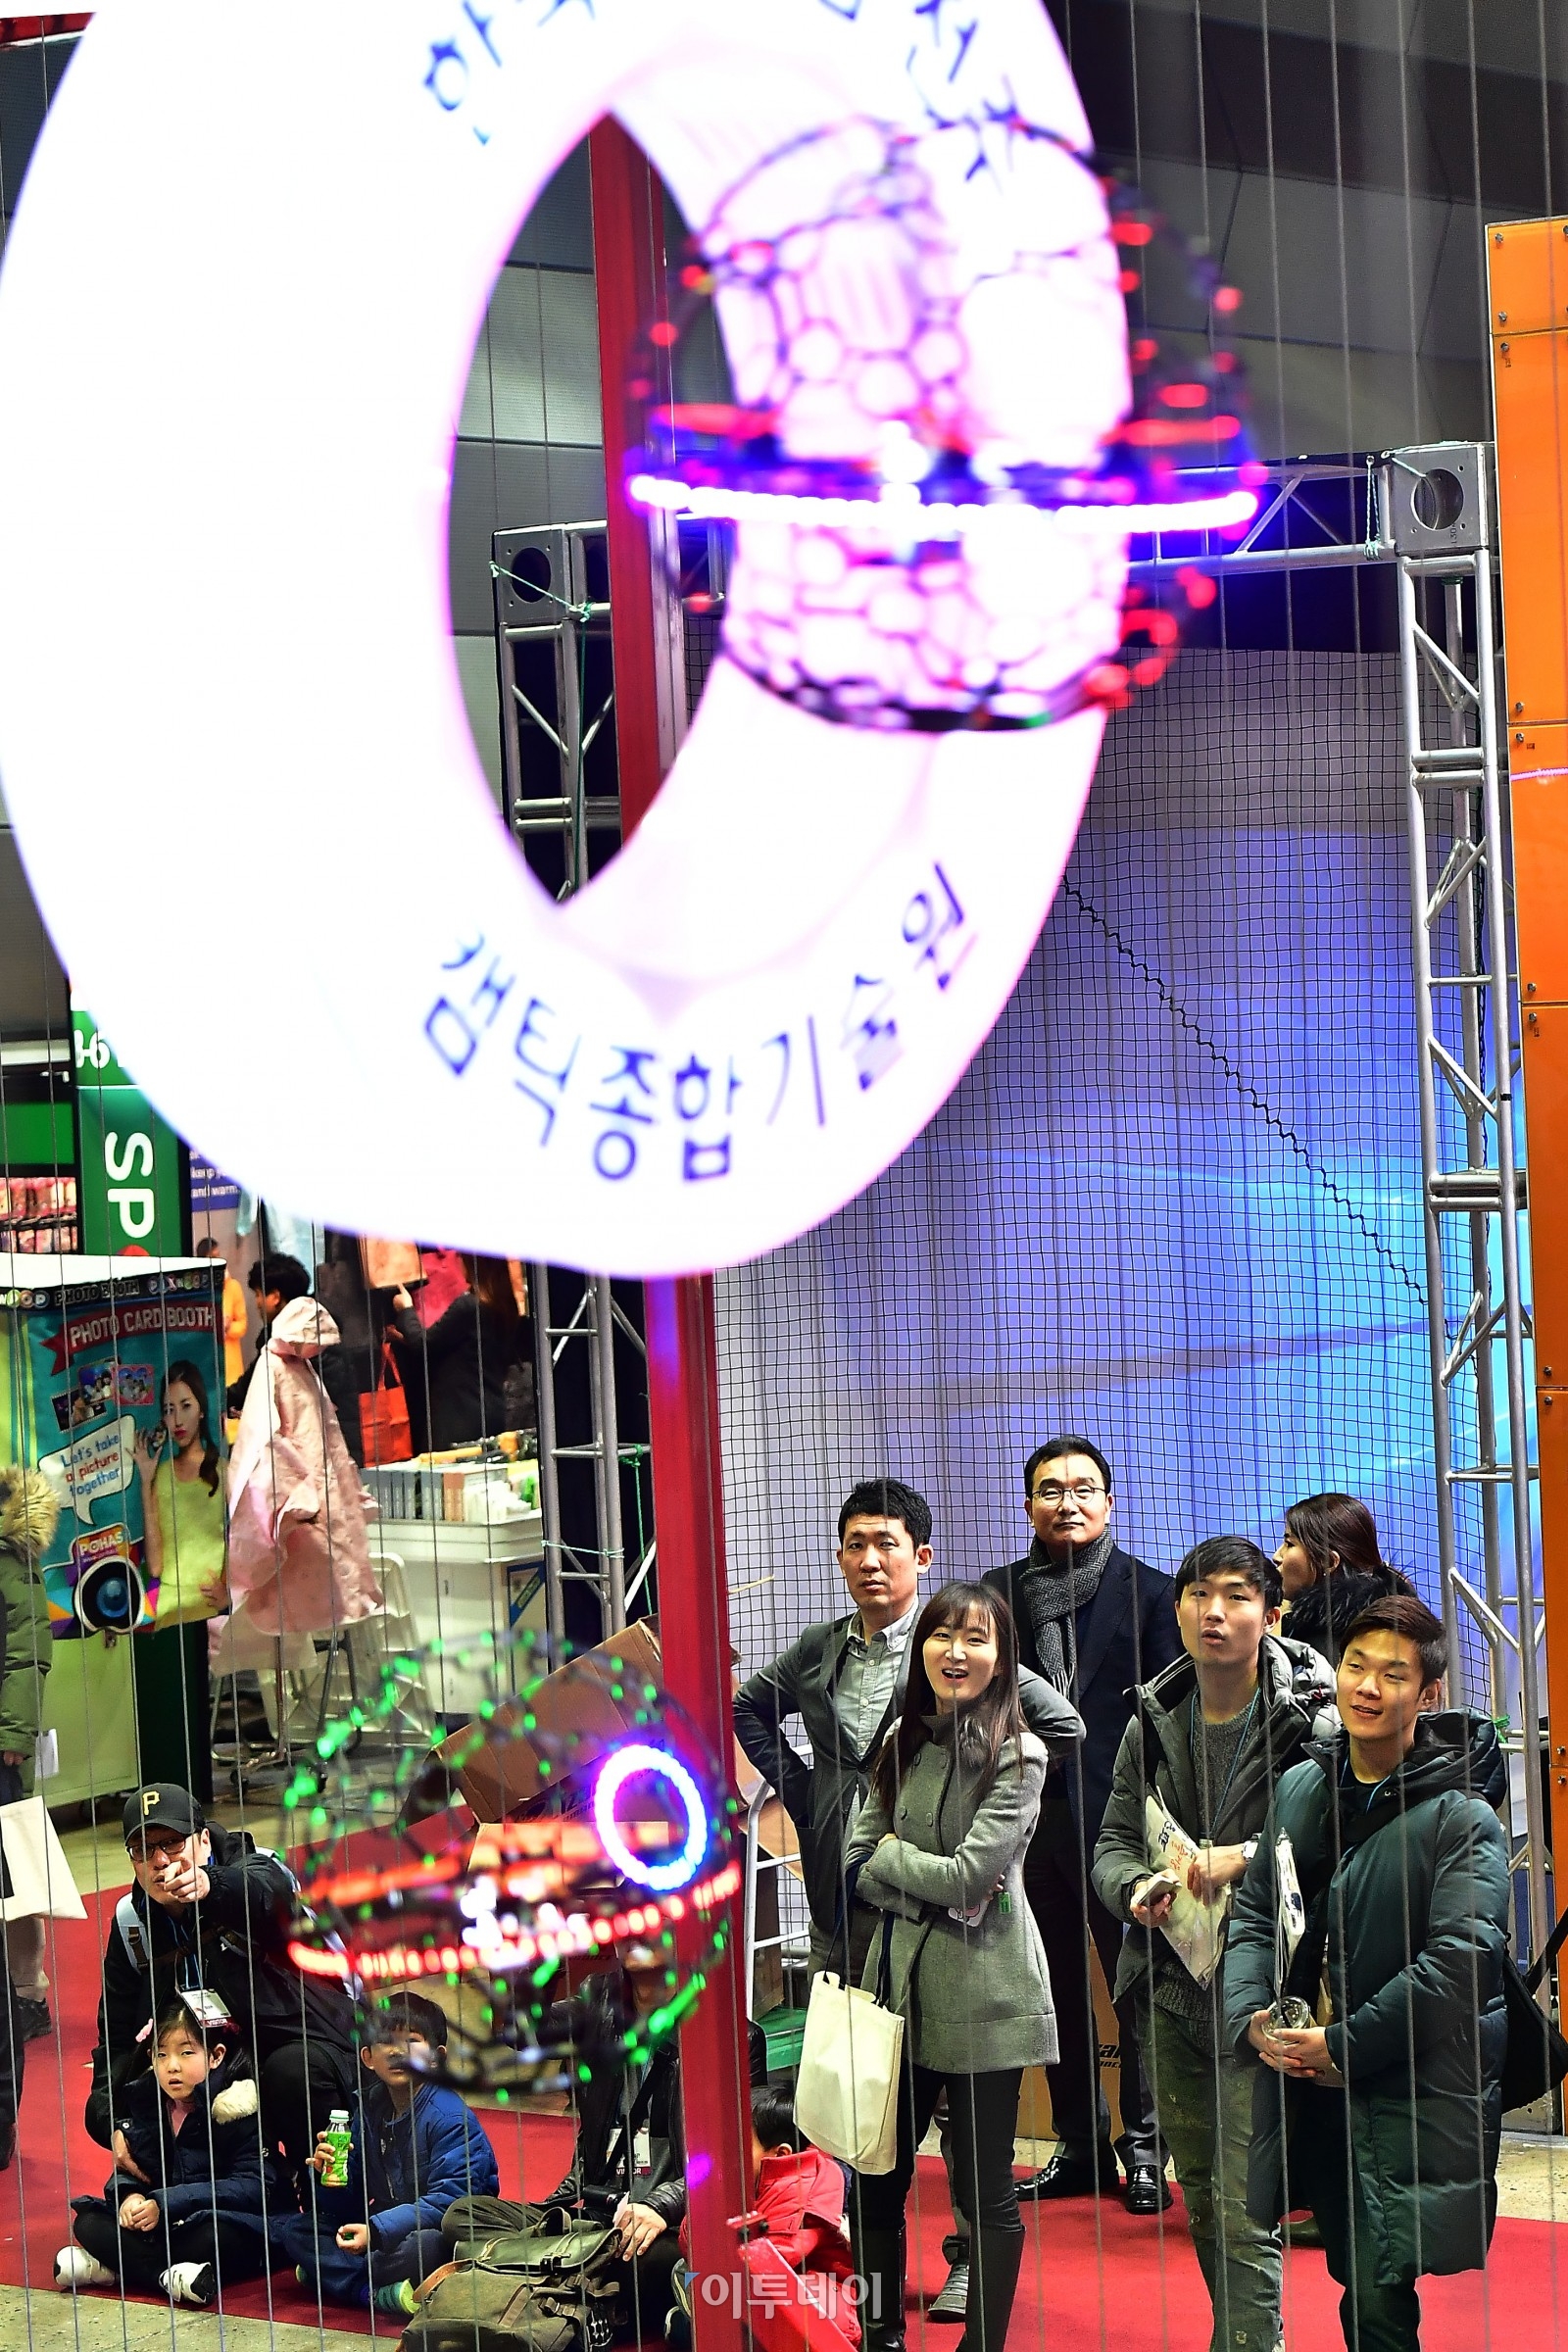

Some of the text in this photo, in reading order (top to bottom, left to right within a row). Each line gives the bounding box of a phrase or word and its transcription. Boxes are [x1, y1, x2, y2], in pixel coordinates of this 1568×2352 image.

[424, 860, 978, 1183] 캠틱종합기술원
[70, 1306, 215, 1348] PHOTO CARD BOOTH
[61, 1435, 119, 1467] Let's take
[66, 1452, 119, 1482] a picture
[70, 1468, 120, 1497] together
[142, 1790, 160, 1815] P
